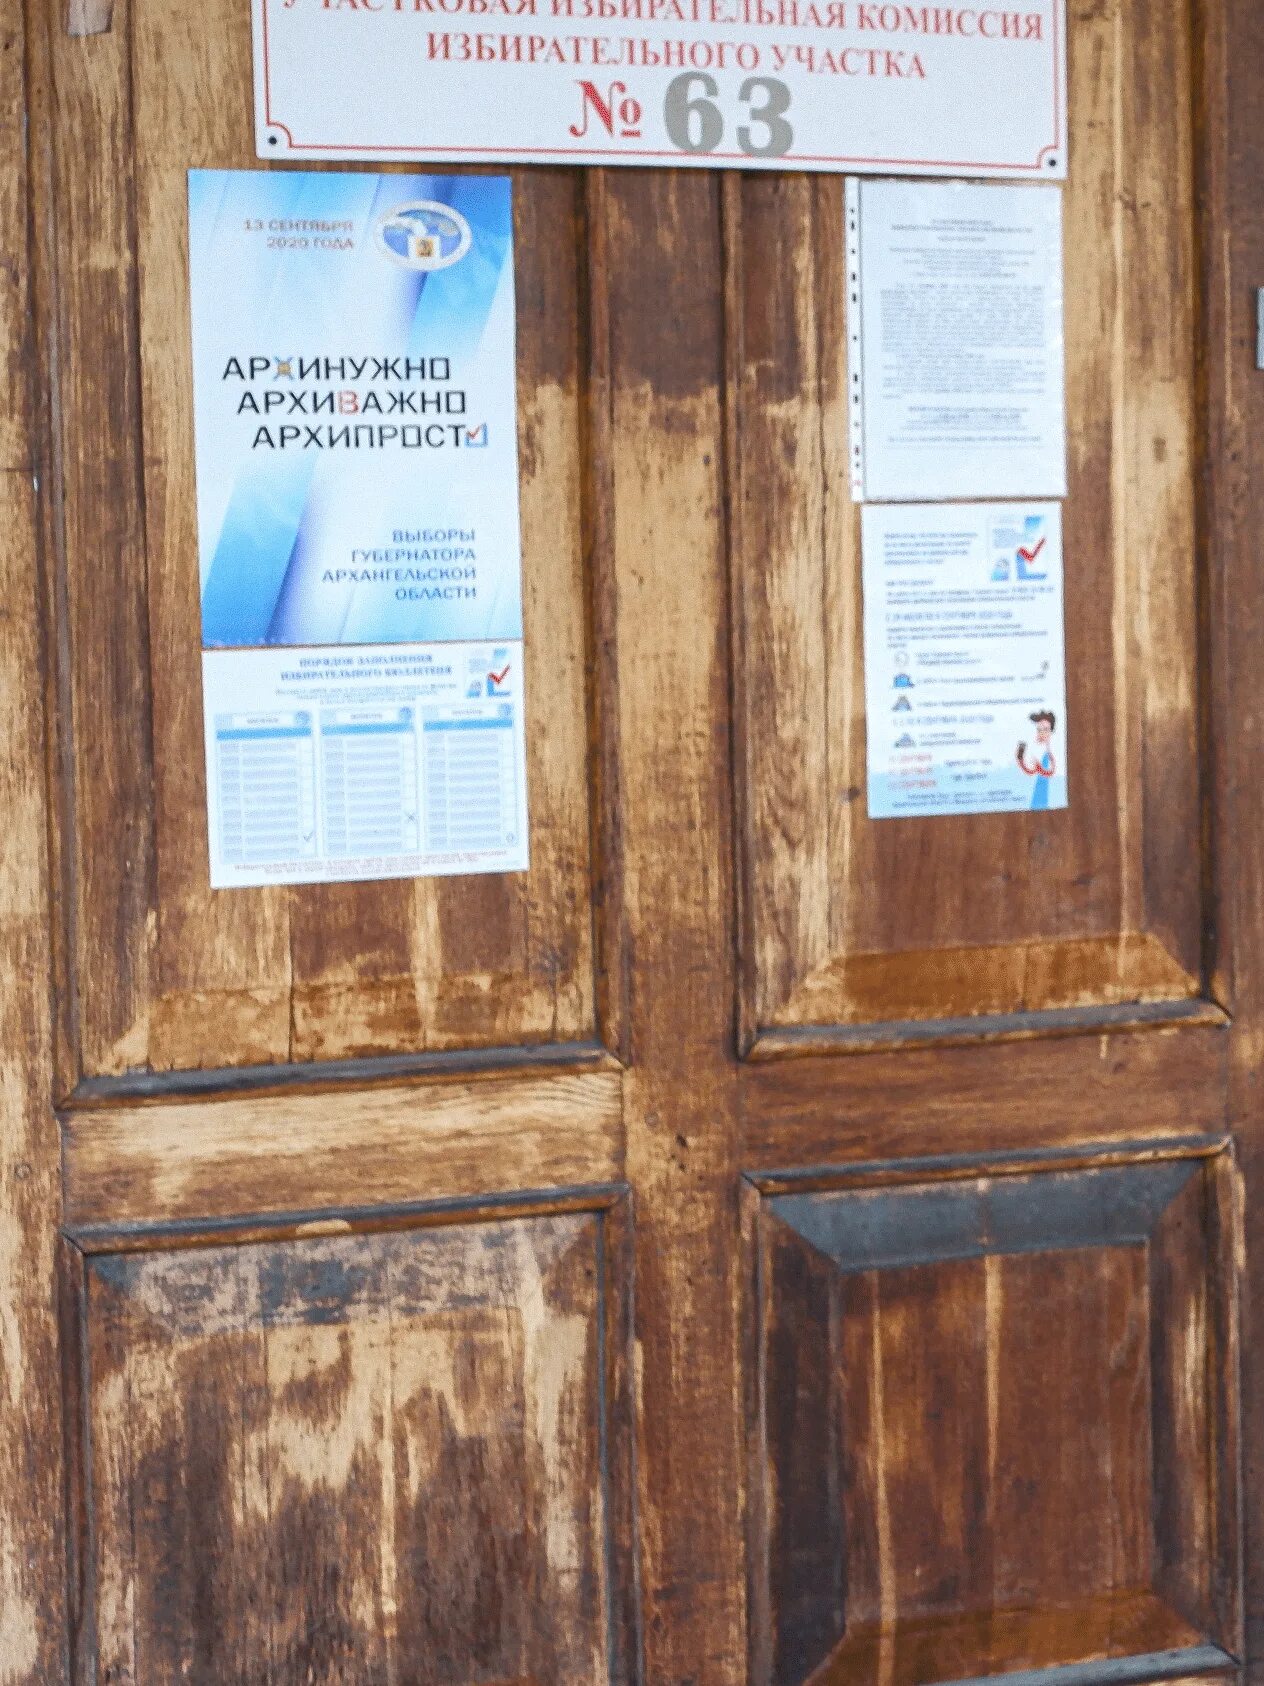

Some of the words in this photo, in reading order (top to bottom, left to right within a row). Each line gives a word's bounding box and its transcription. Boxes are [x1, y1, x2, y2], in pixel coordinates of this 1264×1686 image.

[551, 0, 846, 29] ИЗБИРАТЕЛЬНАЯ
[856, 3, 1044, 40] КОМИССИЯ
[426, 31, 761, 71] ИЗБИРАТЕЛЬНОГО
[770, 44, 927, 79] УЧАСТКА
[663, 71, 794, 158] 63
[268, 219, 353, 232] СЕНТЯБРЯ
[313, 237, 353, 250] ГОДА
[222, 356, 451, 381] АРХИНУЖНО
[237, 390, 467, 416] АРХИВАЖНО
[392, 528, 476, 543] ВЫБОРЫ
[351, 548, 477, 563] ГУБЕРНАТОРА
[321, 565, 477, 583] АРХАНГЕЛЬСКОЙ
[394, 586, 477, 600] ОБЛАСТИ
